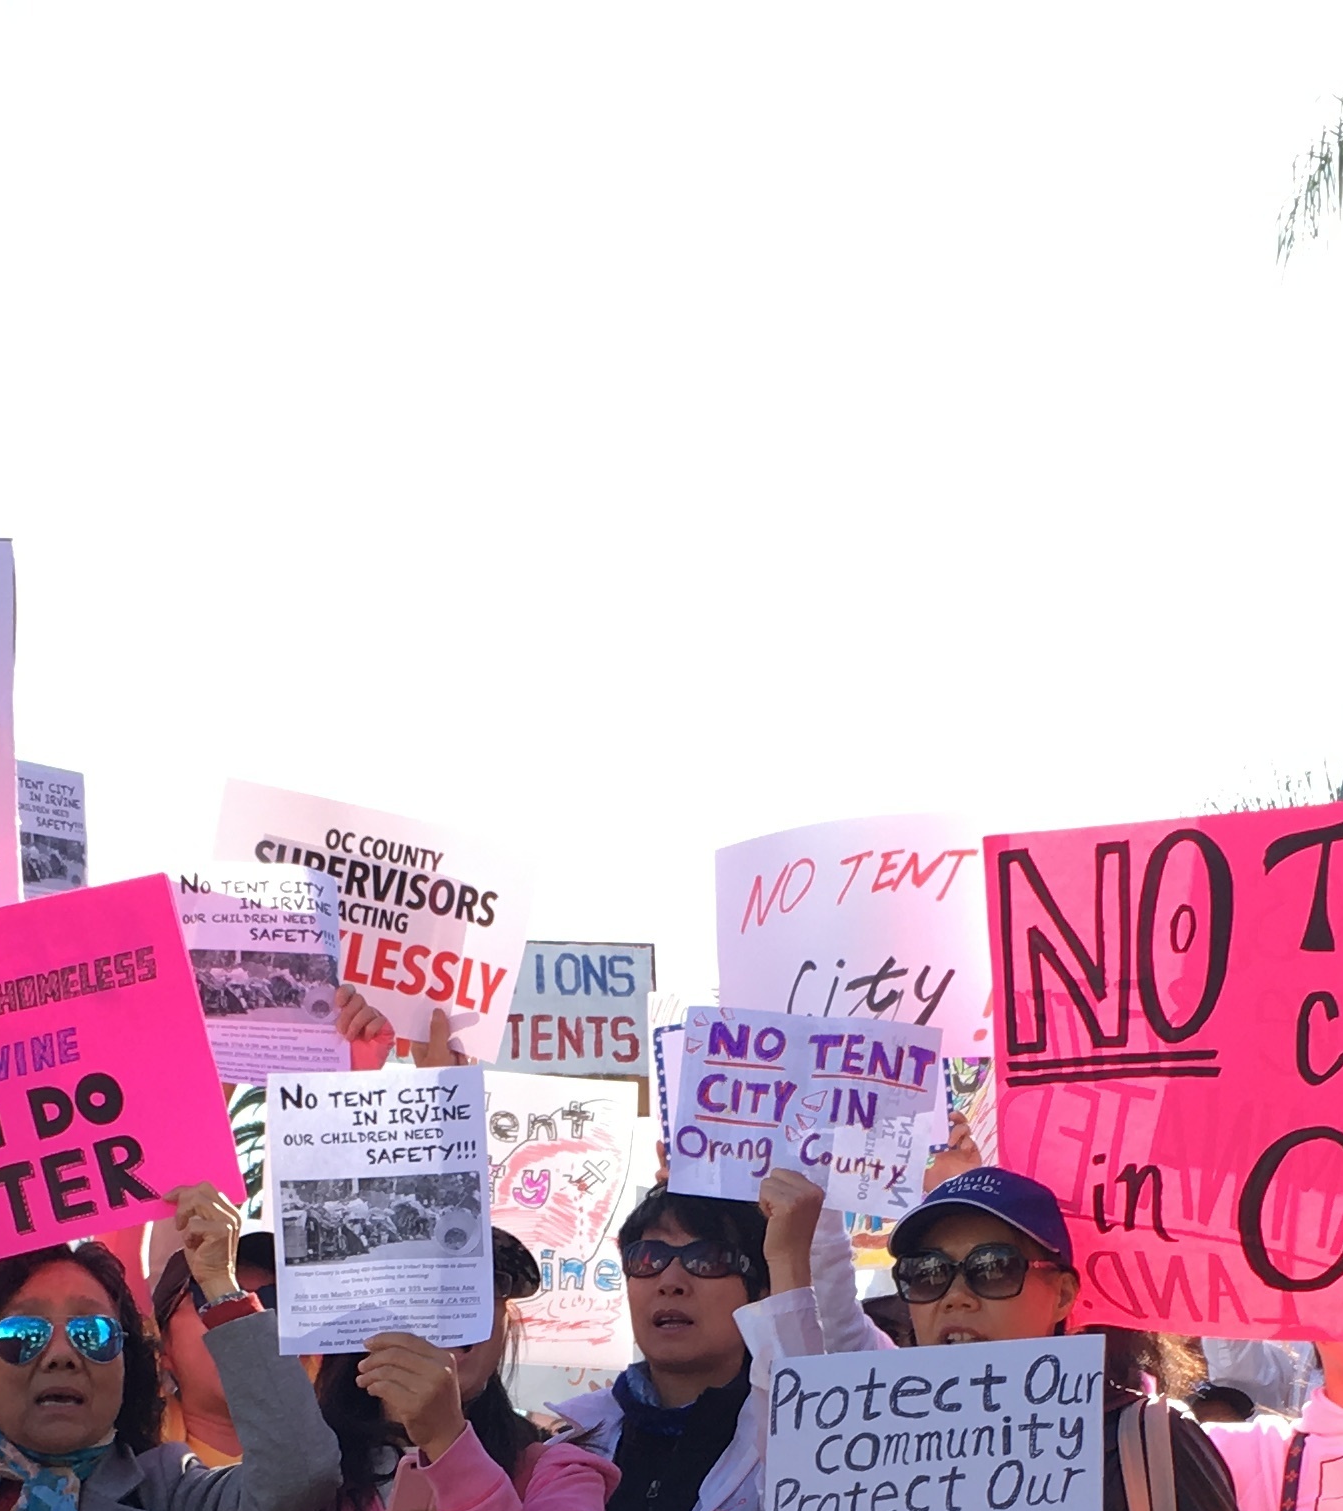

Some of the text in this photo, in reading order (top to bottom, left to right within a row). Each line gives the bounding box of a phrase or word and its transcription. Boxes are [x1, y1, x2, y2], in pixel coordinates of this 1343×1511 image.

[18, 777, 75, 796] TENT CITY
[29, 791, 81, 809] IN IRVINE
[325, 828, 445, 873] OC COUNTY
[180, 873, 324, 897] No TENT CITY
[239, 895, 332, 916] IN IRVINE
[741, 849, 978, 934] NO TENT
[183, 914, 316, 925] OUR CHILDREN NEED
[249, 928, 335, 948] SAFETY!!!
[999, 829, 1234, 1055] NO
[339, 929, 507, 1014] LESSLY
[508, 1013, 641, 1063] TENTS
[708, 1022, 935, 1086] NO TENT
[27, 1072, 124, 1139] DO
[280, 1084, 459, 1110] No TENT CITY
[353, 1104, 471, 1126] IN IRVINE
[696, 1074, 878, 1129] CITY IN
[284, 1128, 444, 1146] OUR CHILDREN NEED
[490, 1101, 594, 1143] ent
[367, 1141, 477, 1165] SAFETY!!!
[799, 1133, 906, 1189] County
[1092, 1154, 1179, 1243] in
[541, 1249, 621, 1292] ine
[770, 1353, 1104, 1436] Protect Our
[815, 1412, 1085, 1475] community
[987, 1460, 1086, 1510] Our
